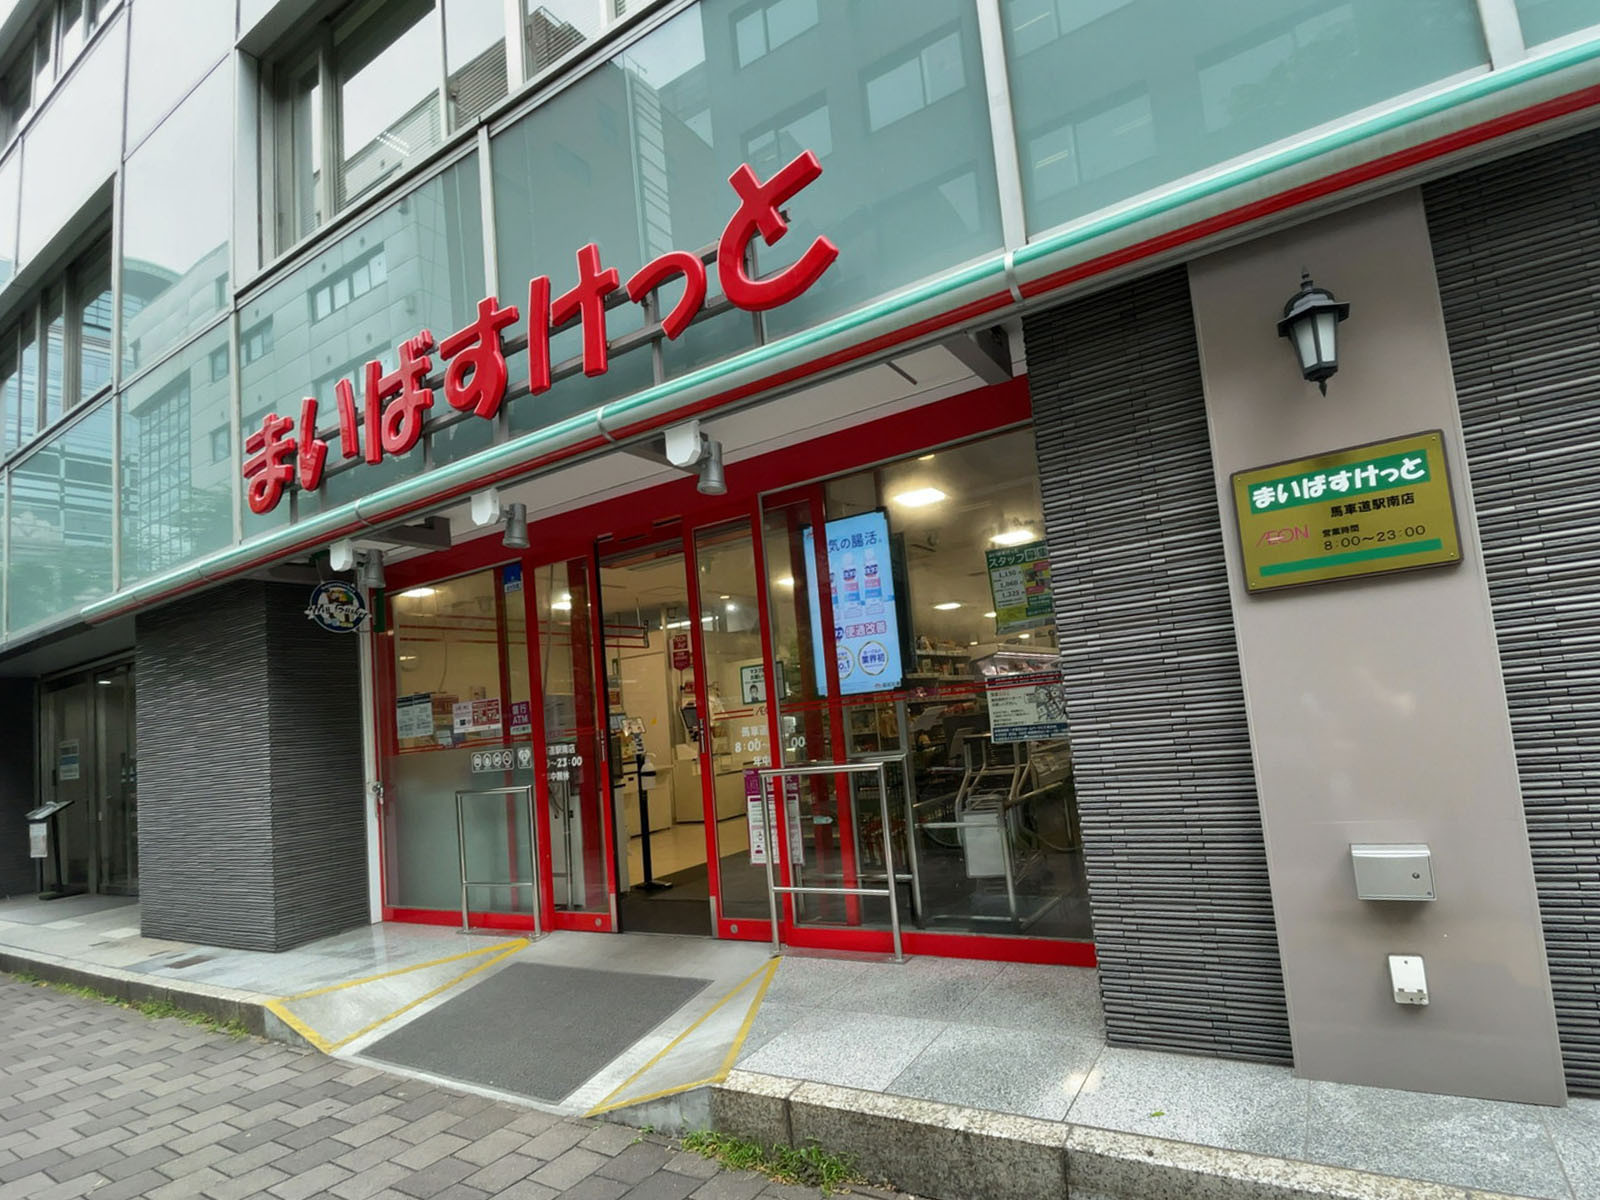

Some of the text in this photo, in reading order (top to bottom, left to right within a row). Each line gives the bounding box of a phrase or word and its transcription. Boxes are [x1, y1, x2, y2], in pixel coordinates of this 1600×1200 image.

[243, 149, 839, 514] まいばすけっと
[1252, 457, 1426, 509] まいばすけっと
[1330, 492, 1415, 518] 馬車道駅南店
[1322, 524, 1360, 538] 営業時間
[512, 714, 529, 726] ATM
